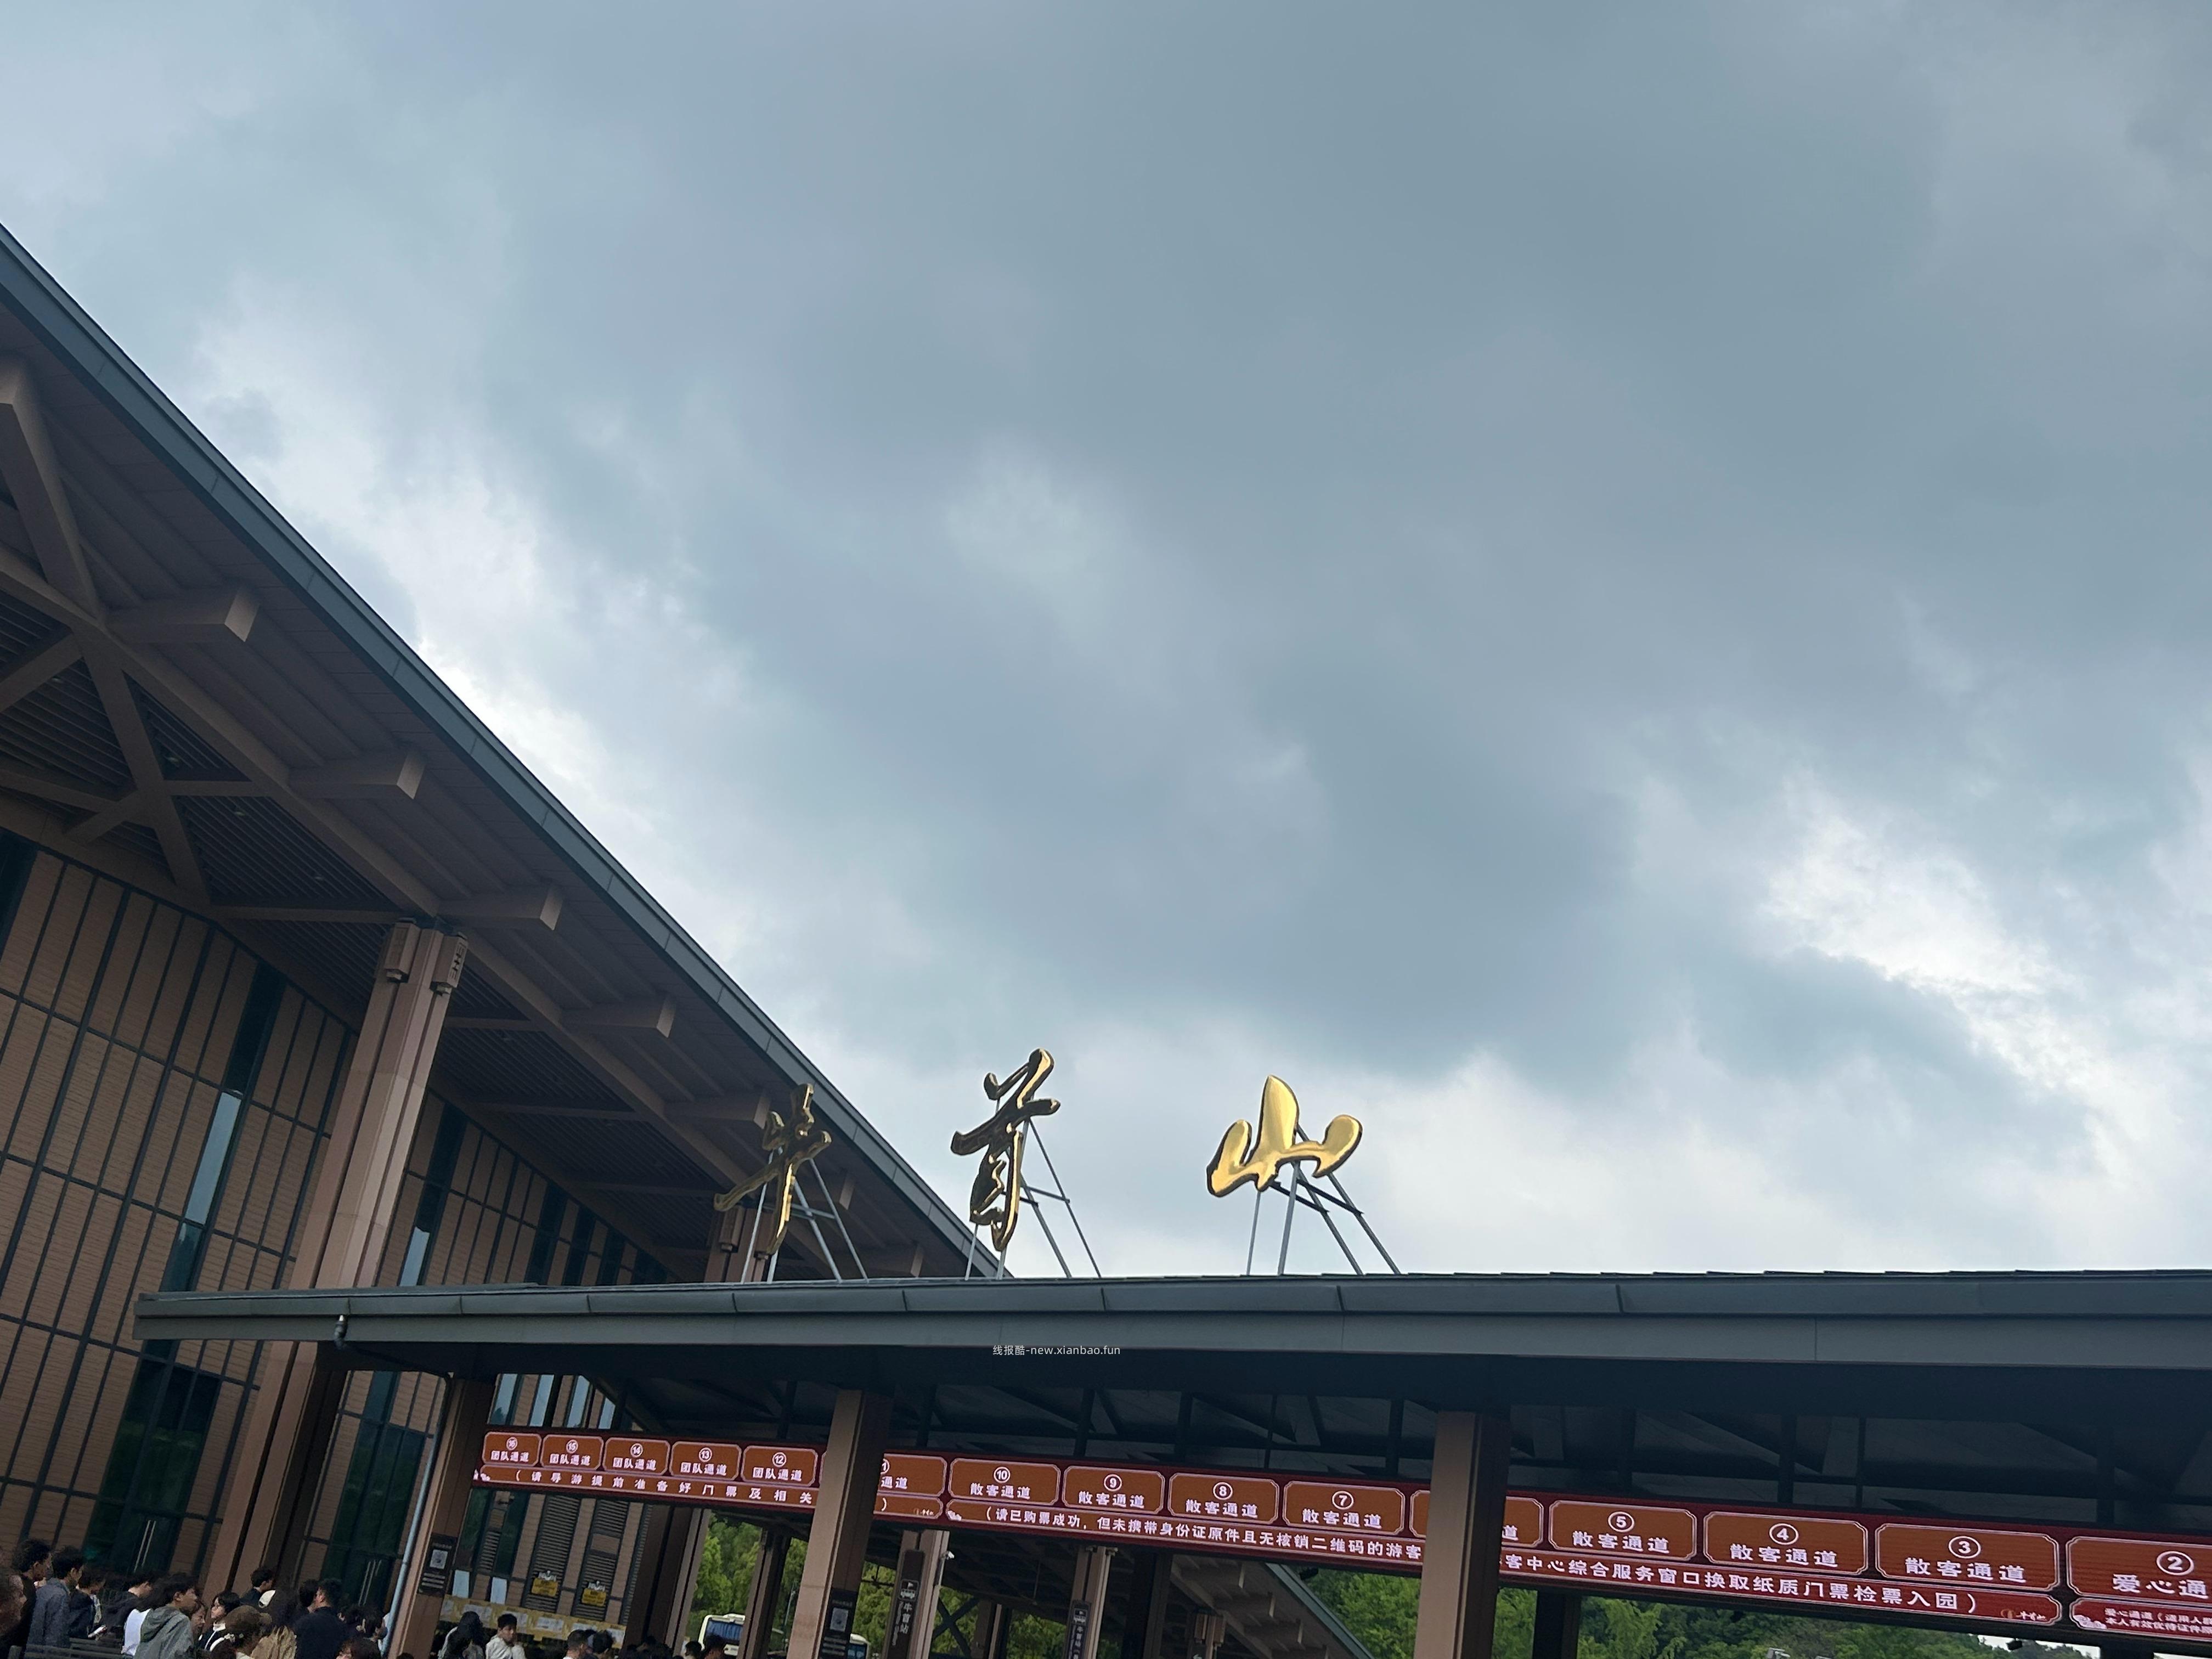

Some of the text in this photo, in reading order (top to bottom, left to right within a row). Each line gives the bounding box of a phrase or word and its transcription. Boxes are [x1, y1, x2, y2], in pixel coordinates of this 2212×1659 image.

[714, 1048, 1363, 1255] 牛首山
[490, 1450, 529, 1463] 团队通道
[549, 1453, 591, 1466] 团队通道
[612, 1457, 657, 1471] 团队通道
[680, 1462, 728, 1476] 团队通道
[752, 1466, 803, 1481] 团队通道
[970, 1482, 1031, 1500] 散客通道
[1078, 1491, 1145, 1509] 散客通道
[1185, 1498, 1259, 1519] 散客通道
[1302, 1508, 1383, 1530] 散客通道
[1572, 1530, 1670, 1554] 散客通道
[1729, 1543, 1838, 1568] 散客通道
[1905, 1557, 2027, 1583] 散客通道
[1499, 1553, 1977, 1614] 客中心综合服务窗口换取纸质门票检票入园）
